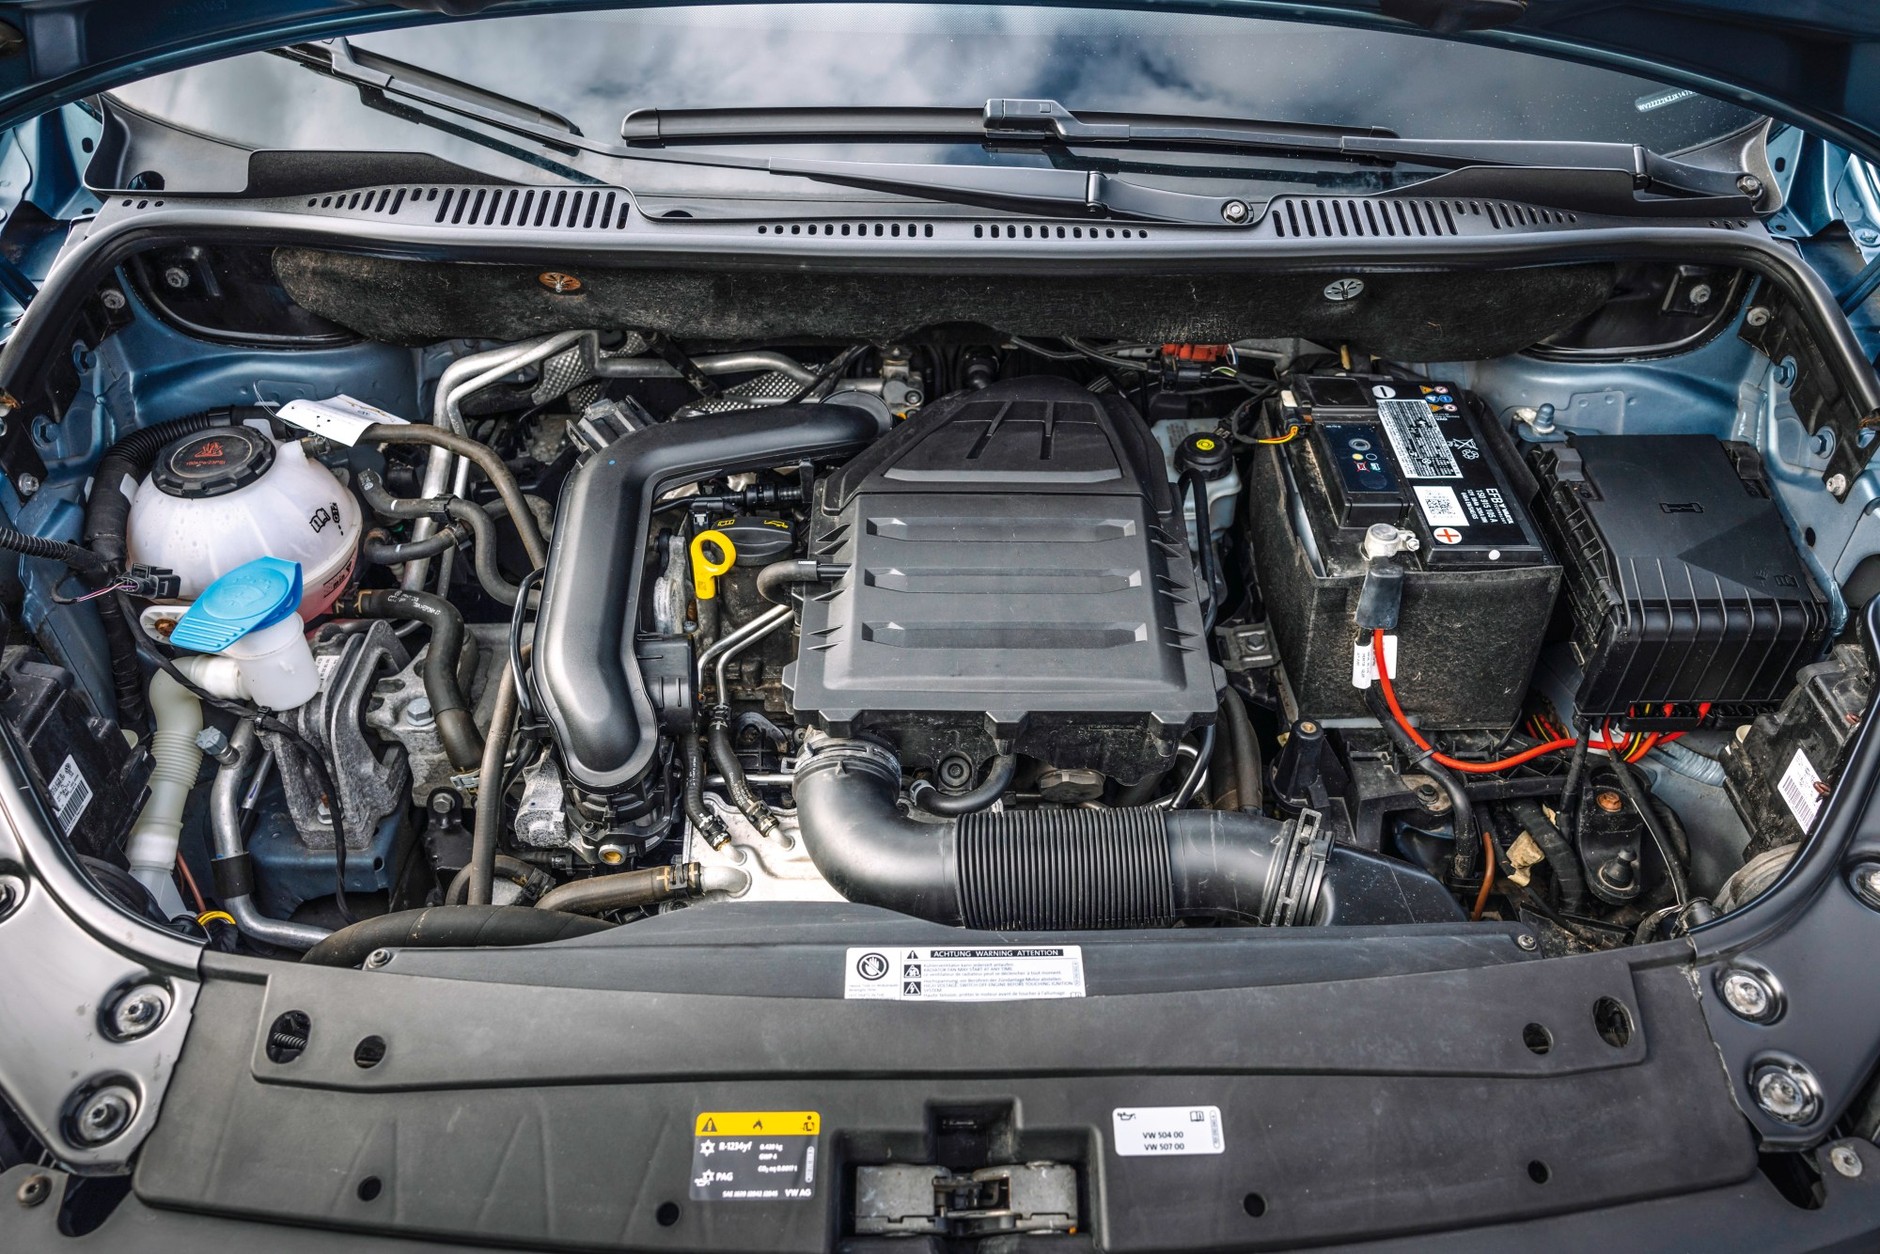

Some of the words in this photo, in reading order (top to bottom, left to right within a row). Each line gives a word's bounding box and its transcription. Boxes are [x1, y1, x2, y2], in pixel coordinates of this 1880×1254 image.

[1485, 488, 1504, 504] EFB
[718, 1141, 752, 1153] R-1234yf
[716, 1172, 733, 1181] PAG
[785, 1189, 799, 1197] VW
[799, 1188, 811, 1196] AG
